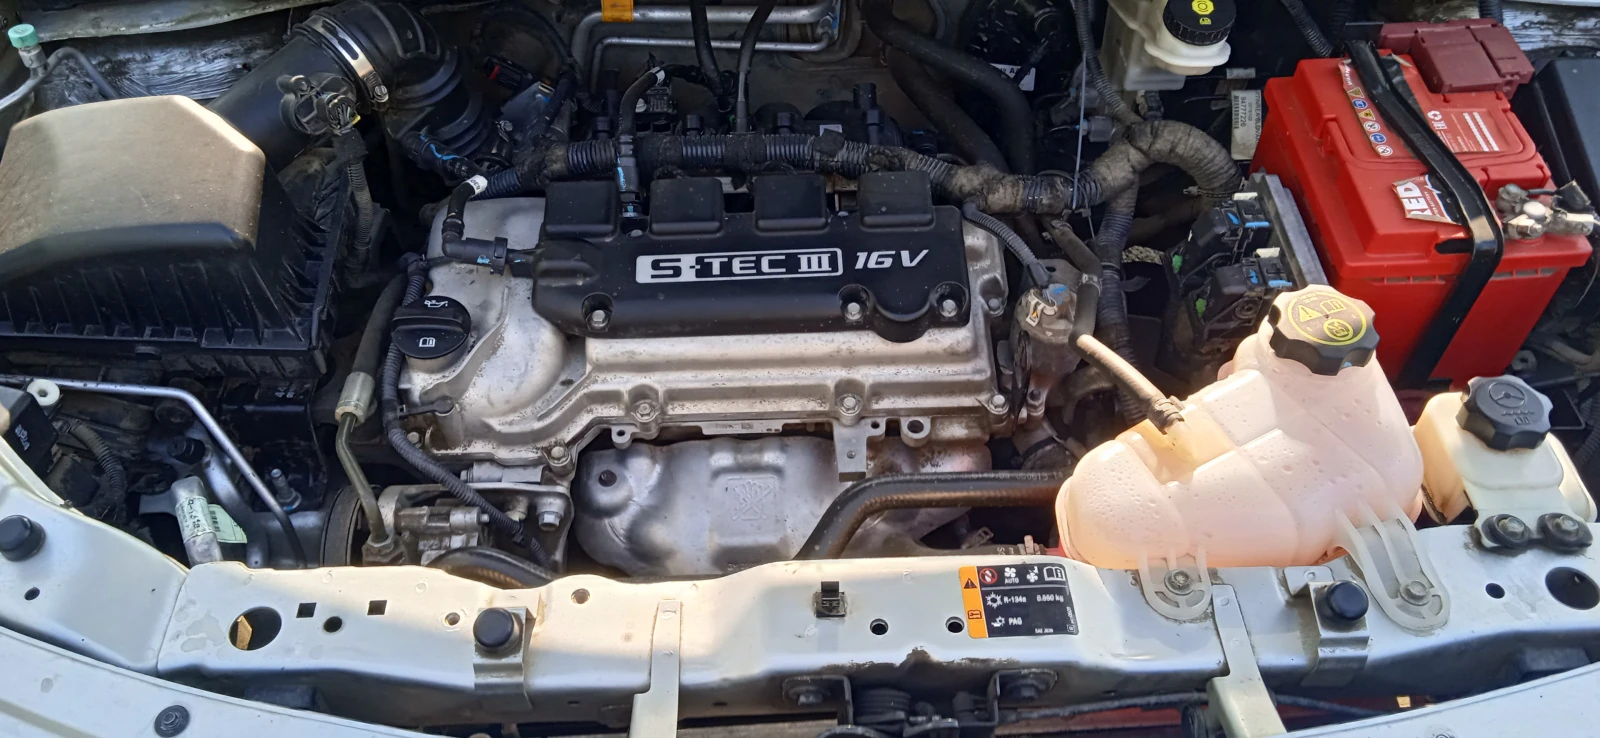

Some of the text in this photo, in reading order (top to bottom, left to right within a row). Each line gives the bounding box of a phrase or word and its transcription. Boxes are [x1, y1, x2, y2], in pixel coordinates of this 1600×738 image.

[650, 249, 929, 279] S-TEC III 16V
[1008, 616, 1022, 625] PAG
